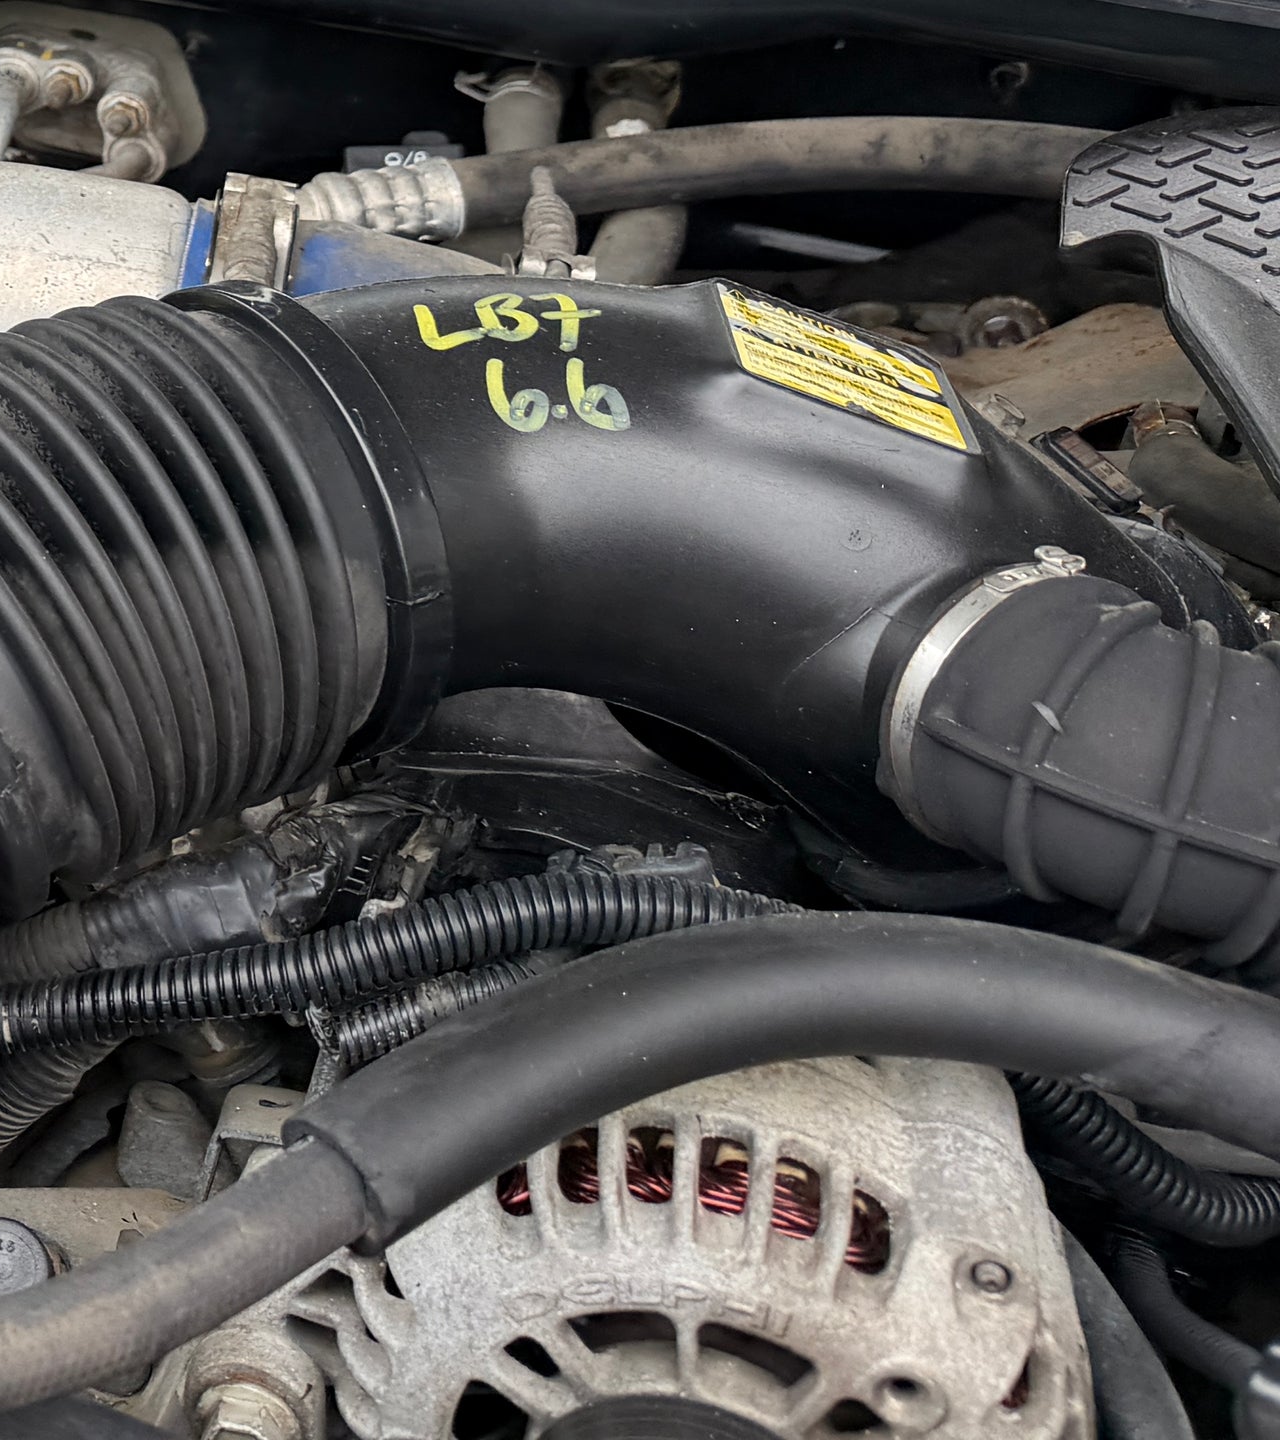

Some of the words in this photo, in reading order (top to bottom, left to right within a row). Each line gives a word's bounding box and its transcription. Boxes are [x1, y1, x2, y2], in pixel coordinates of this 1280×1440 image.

[412, 292, 602, 353] LB7
[758, 300, 858, 341] CAUTION
[772, 336, 900, 389] ATTENTION
[485, 357, 631, 433] 6.6
